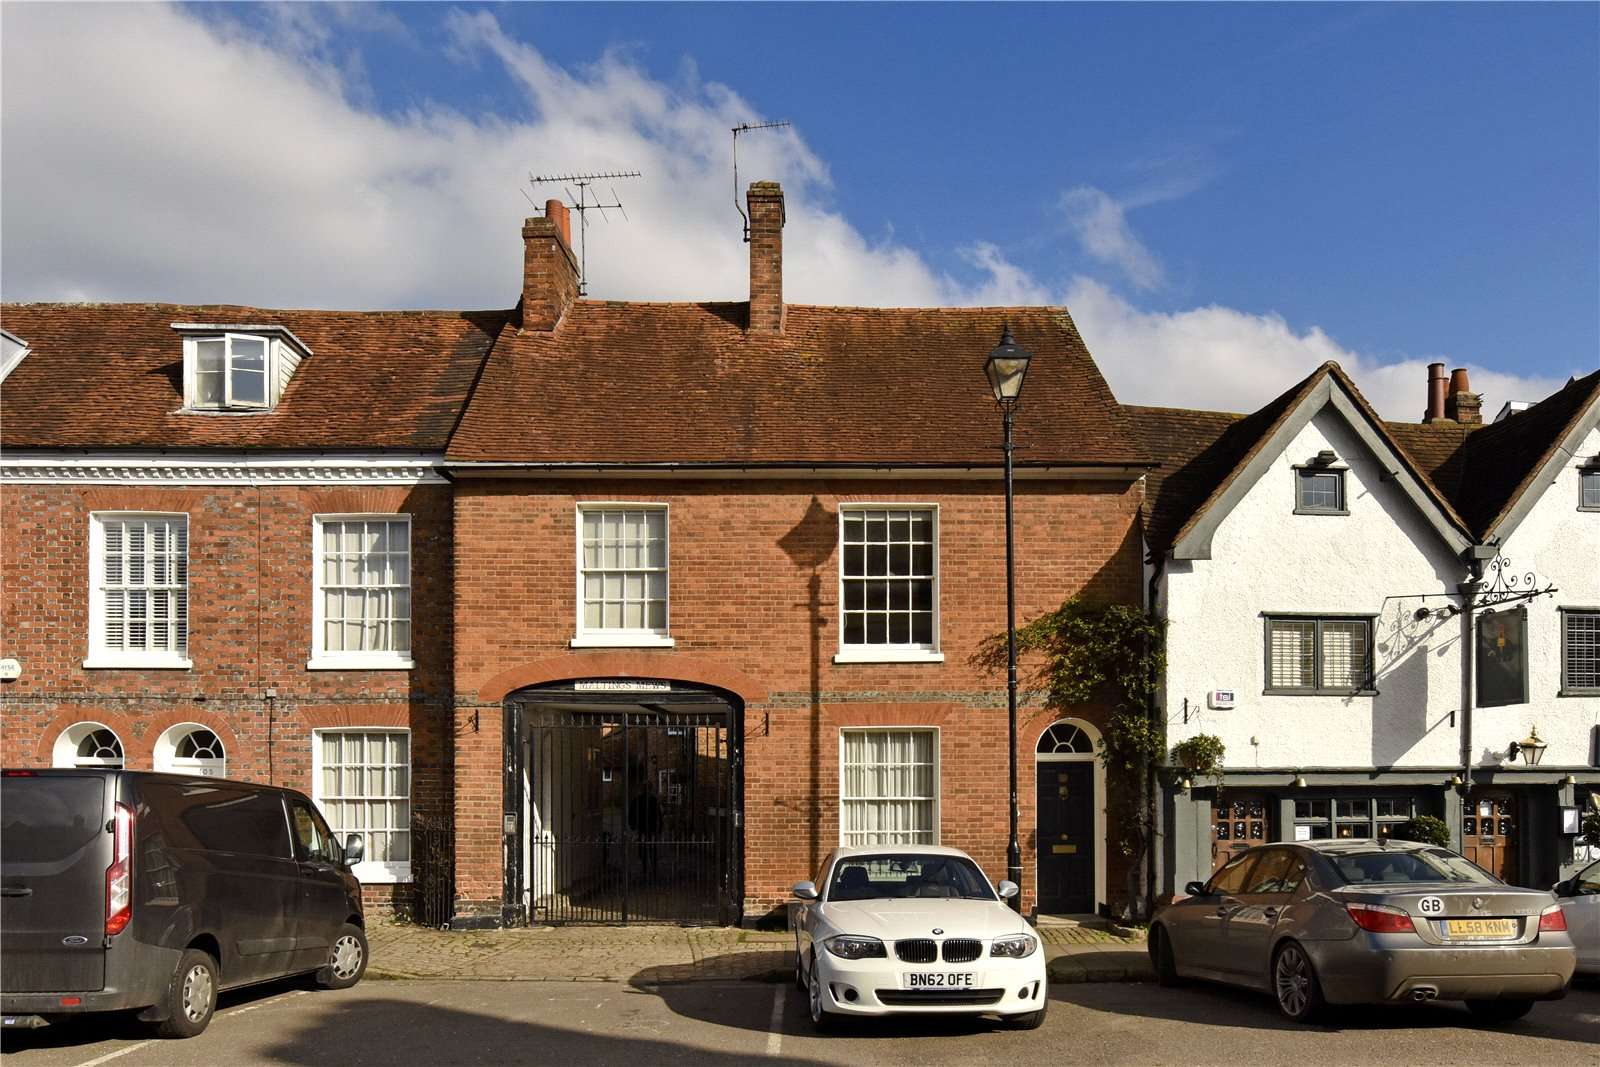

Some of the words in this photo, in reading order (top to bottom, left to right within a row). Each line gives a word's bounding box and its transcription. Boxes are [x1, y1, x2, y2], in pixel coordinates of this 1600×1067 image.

[579, 680, 632, 689] MALTINGS
[636, 680, 667, 690] MEWS
[1421, 899, 1440, 912] GB
[910, 973, 944, 986] BN62
[947, 973, 973, 986] OFE
